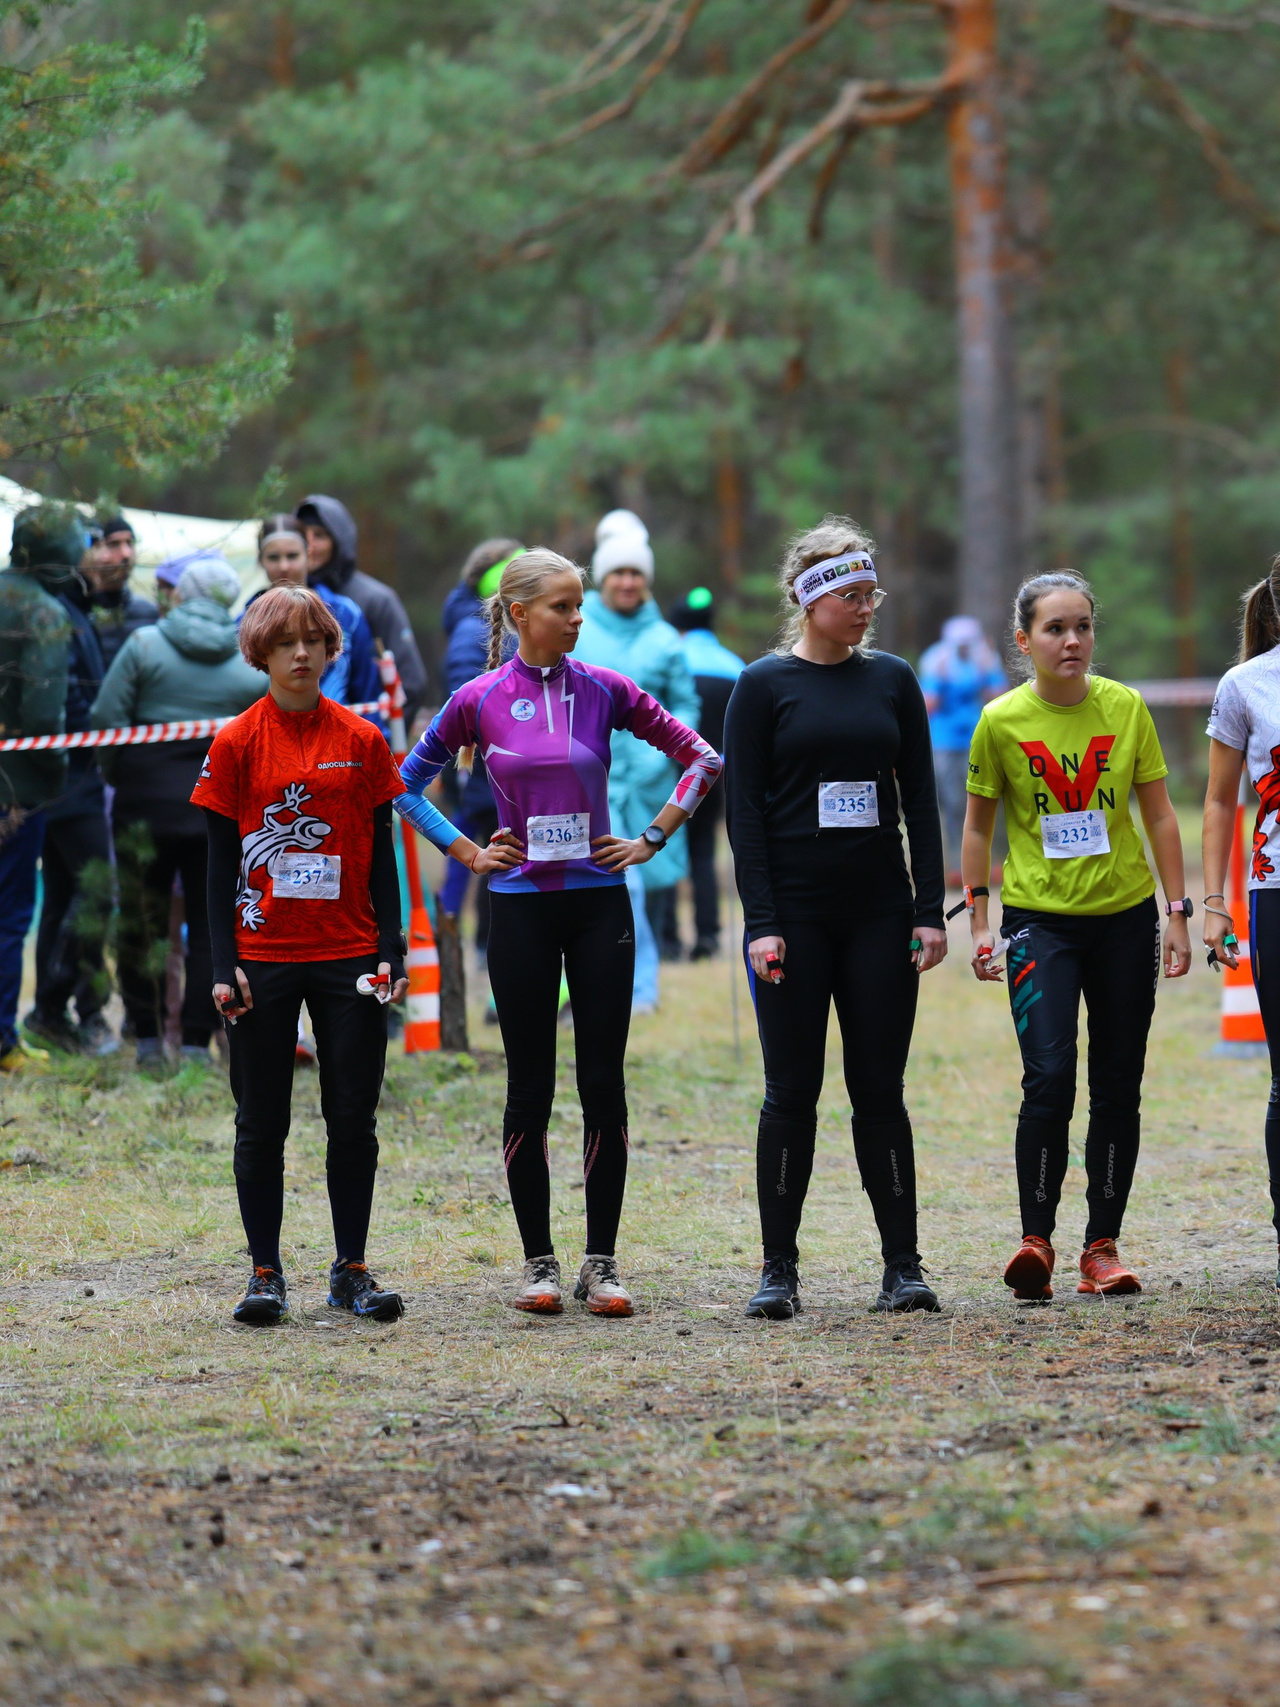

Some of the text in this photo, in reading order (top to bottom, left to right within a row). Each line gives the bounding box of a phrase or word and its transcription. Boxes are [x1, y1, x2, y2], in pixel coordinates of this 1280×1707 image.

[1028, 750, 1111, 778] ONE
[837, 797, 866, 813] 235
[1034, 787, 1116, 815] RUN
[545, 827, 572, 843] 236
[1060, 826, 1089, 844] 232
[292, 869, 322, 885] 237
[781, 1147, 789, 1186] NORD
[890, 1149, 900, 1186] NORD
[1038, 1147, 1048, 1187] NORD
[1106, 1143, 1116, 1184] NORD
